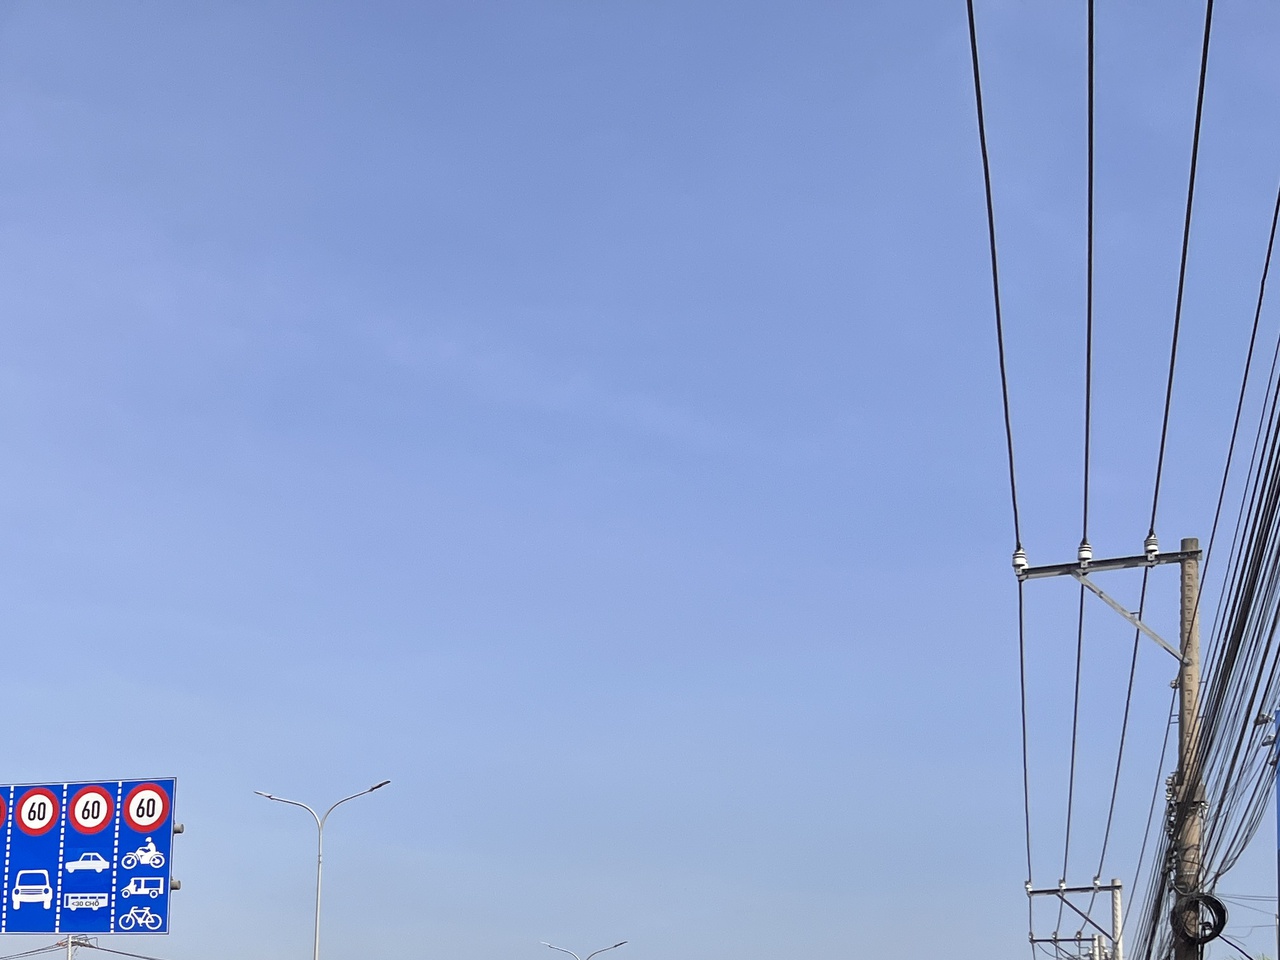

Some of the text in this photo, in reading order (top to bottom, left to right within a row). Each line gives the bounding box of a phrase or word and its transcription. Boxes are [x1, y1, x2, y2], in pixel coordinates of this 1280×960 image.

[27, 801, 46, 821] 60
[81, 800, 100, 820] 60
[136, 798, 156, 818] 60
